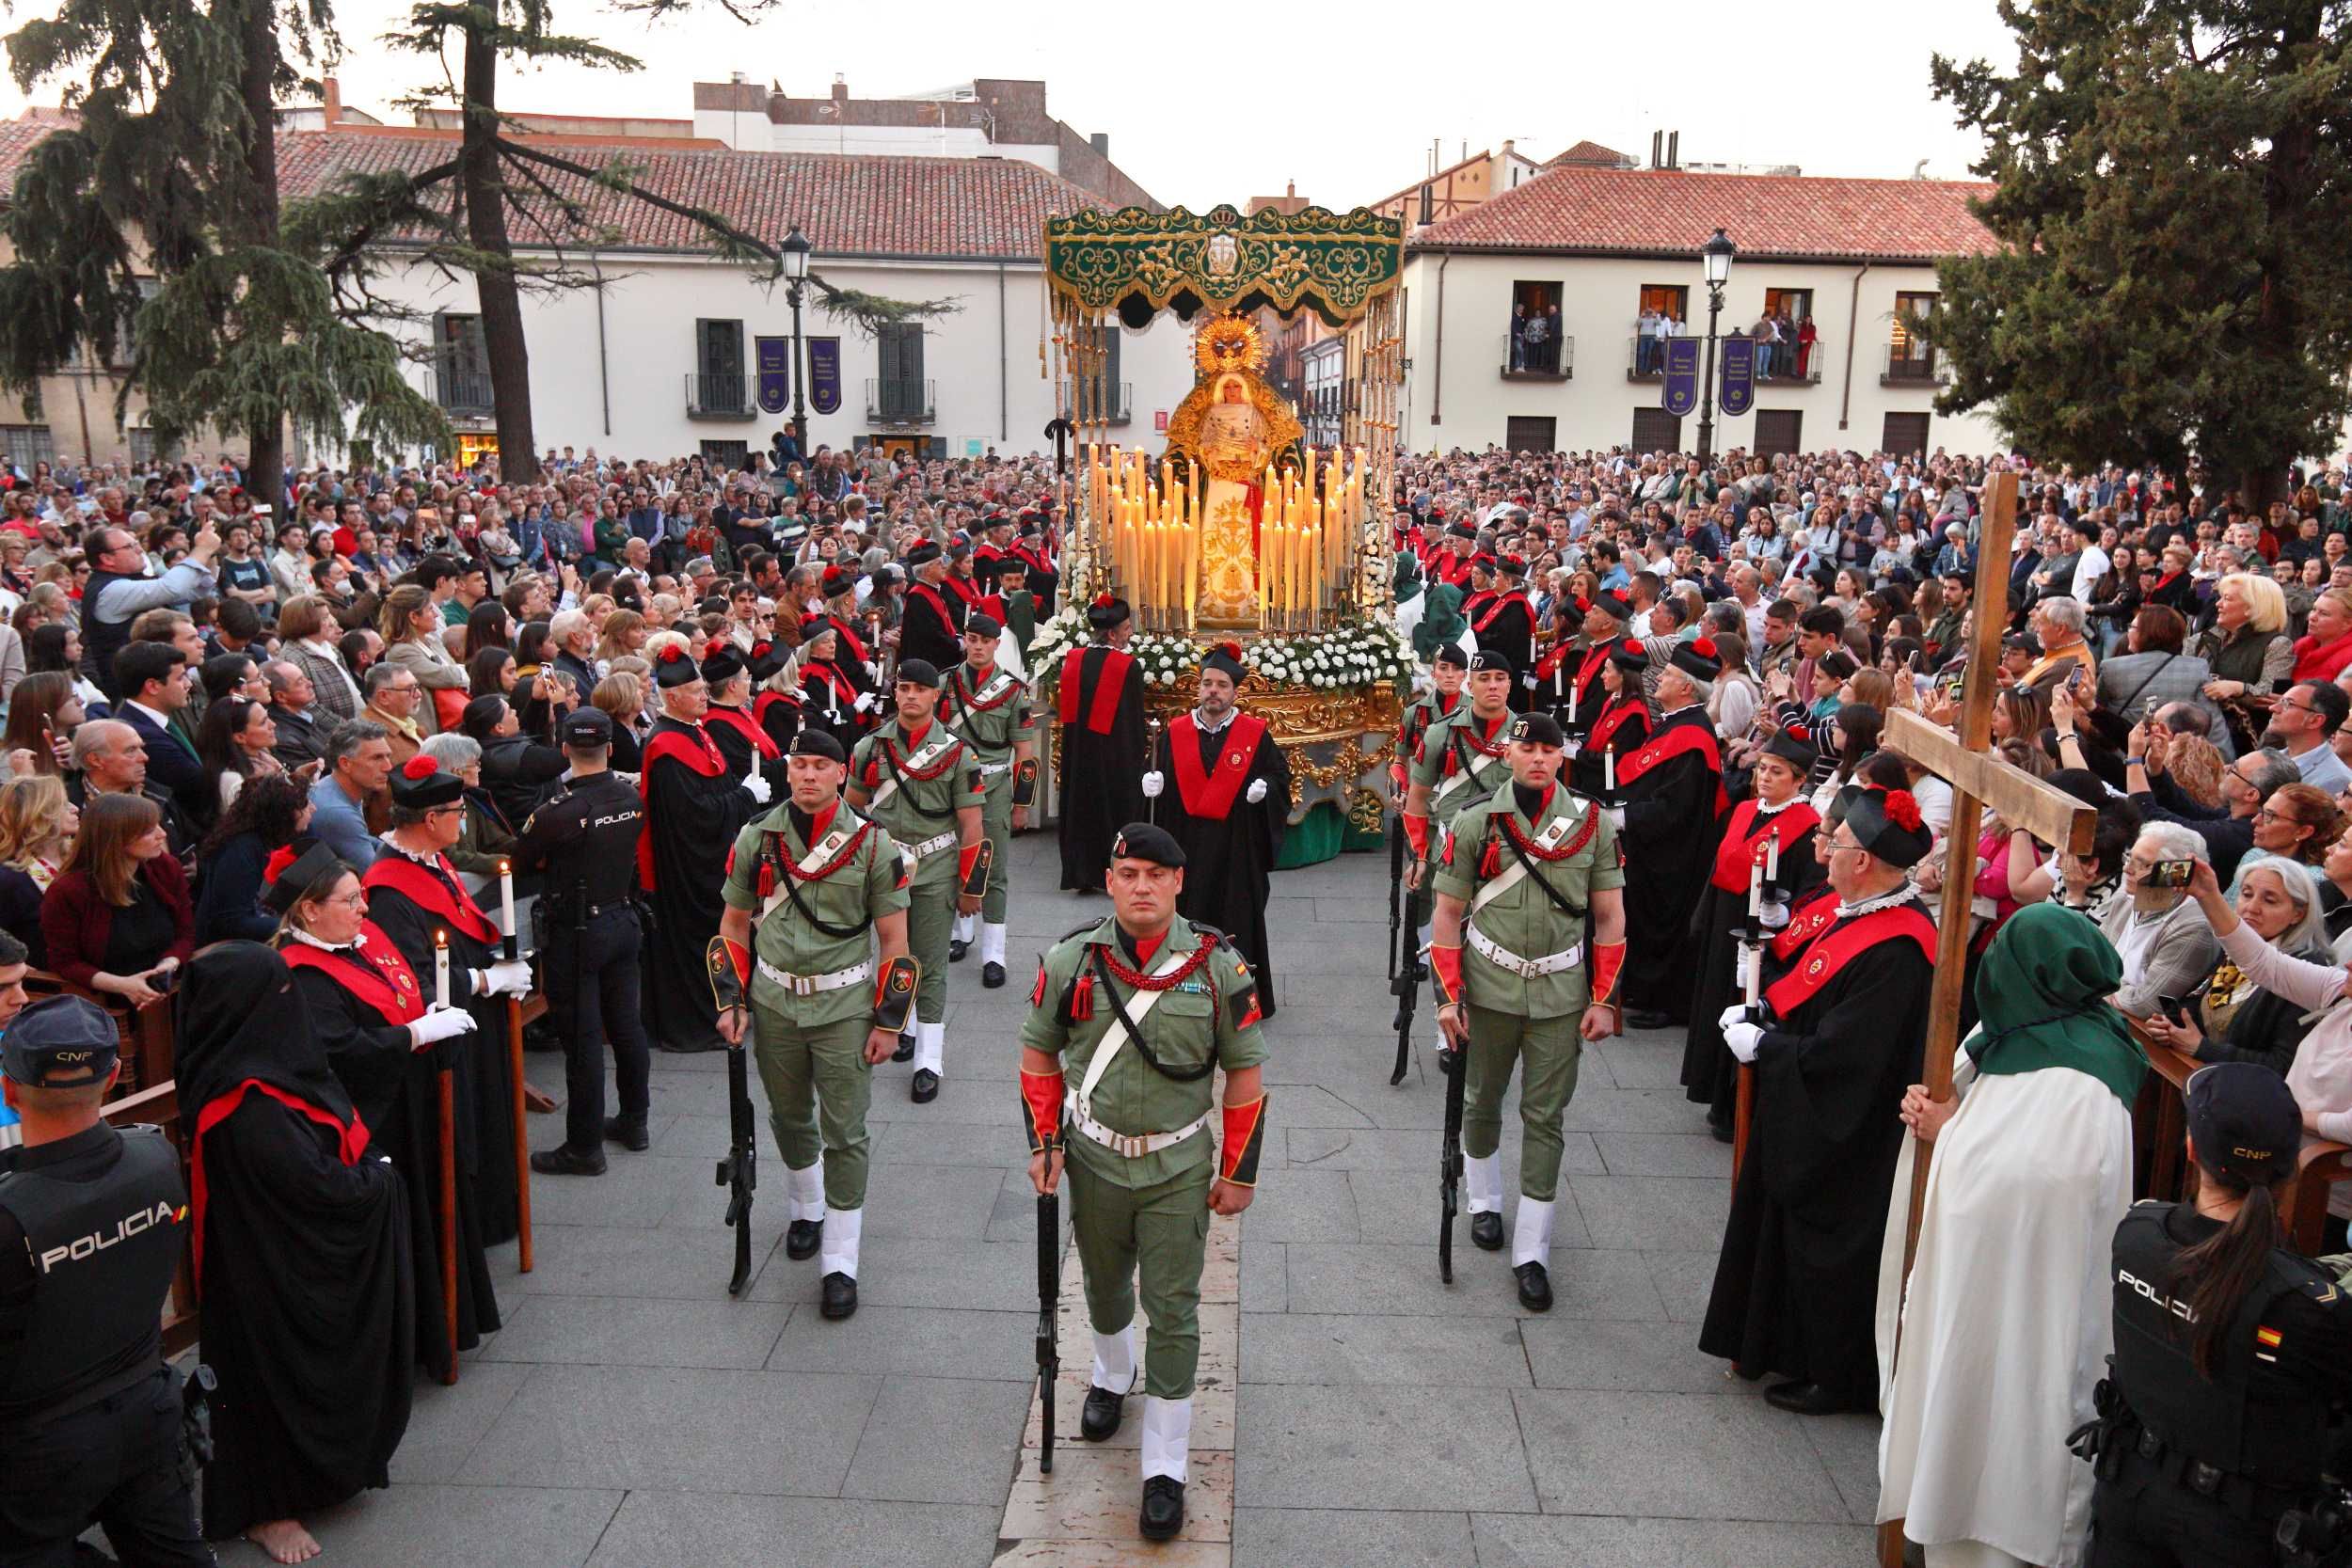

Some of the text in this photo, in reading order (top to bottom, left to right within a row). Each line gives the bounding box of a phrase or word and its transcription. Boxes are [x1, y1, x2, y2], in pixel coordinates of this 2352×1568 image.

[595, 811, 637, 828] POLICIA
[56, 1052, 92, 1061] CNP
[2233, 1148, 2273, 1159] CNP
[40, 1201, 174, 1274] POLICIA
